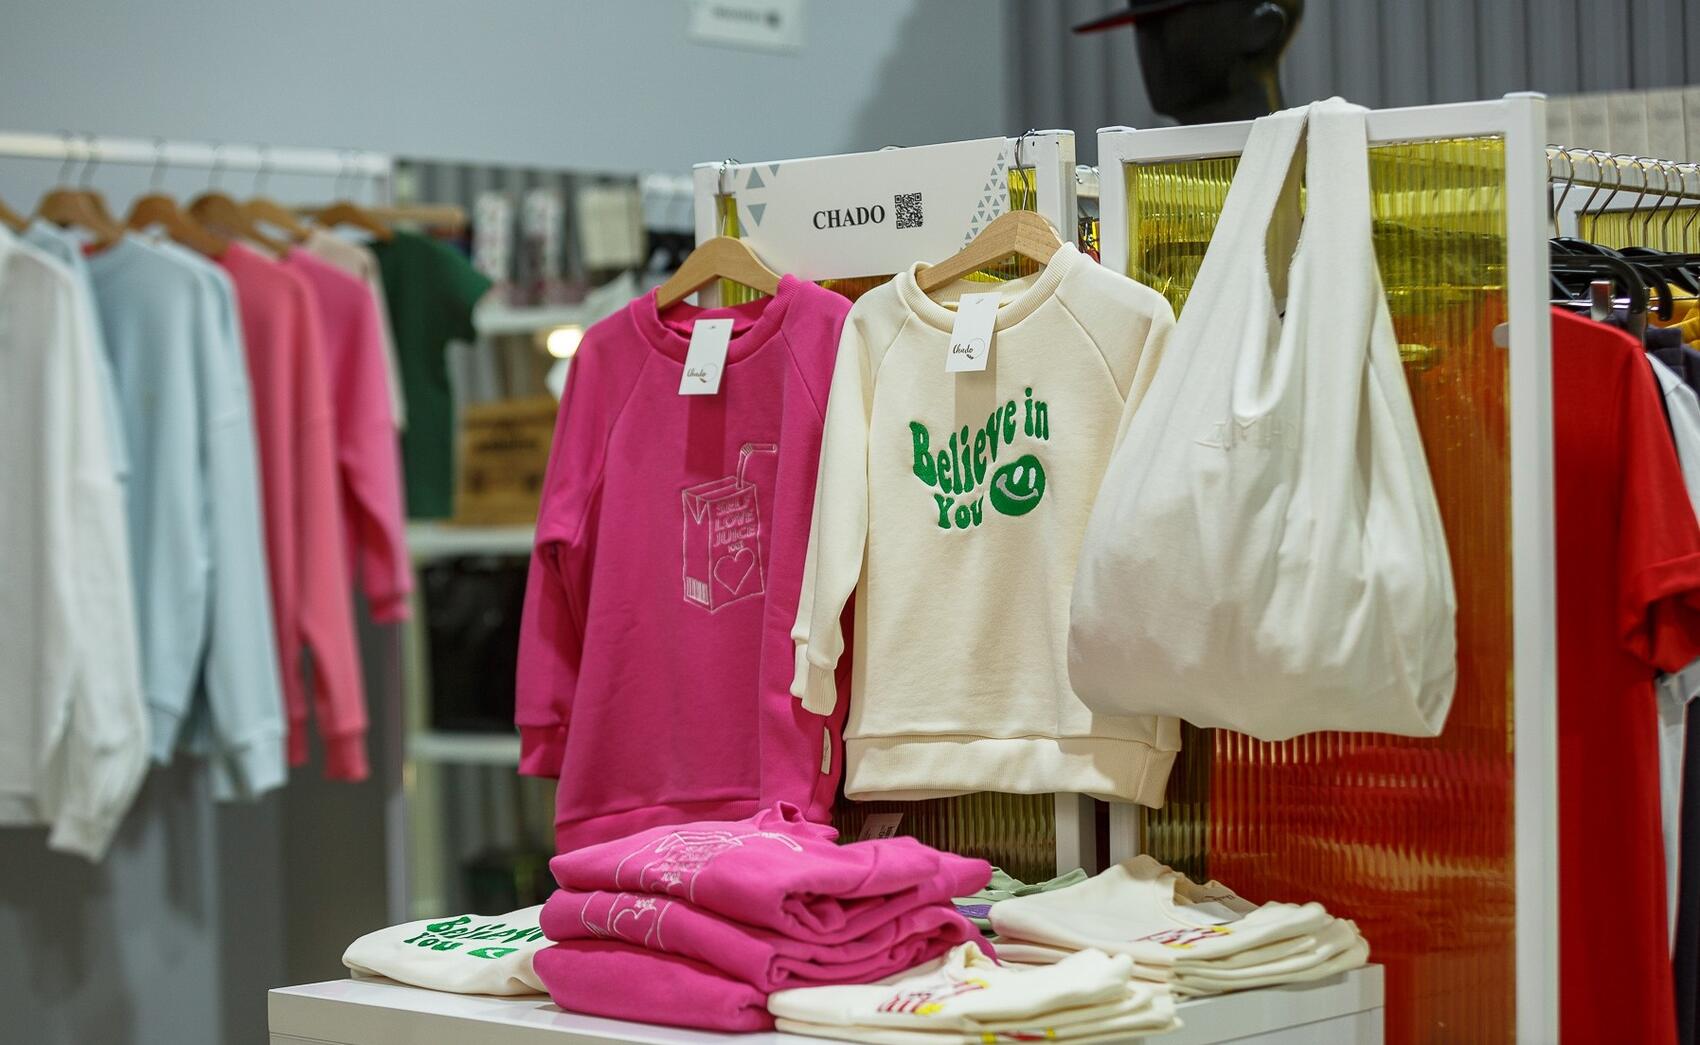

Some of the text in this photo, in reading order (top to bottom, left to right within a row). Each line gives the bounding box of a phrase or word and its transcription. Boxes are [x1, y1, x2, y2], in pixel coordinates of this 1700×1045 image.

[813, 205, 885, 229] CHADO
[909, 387, 1049, 495] Believe in
[715, 509, 755, 532] LOVE
[934, 493, 984, 529] You
[713, 526, 756, 548] JUICE
